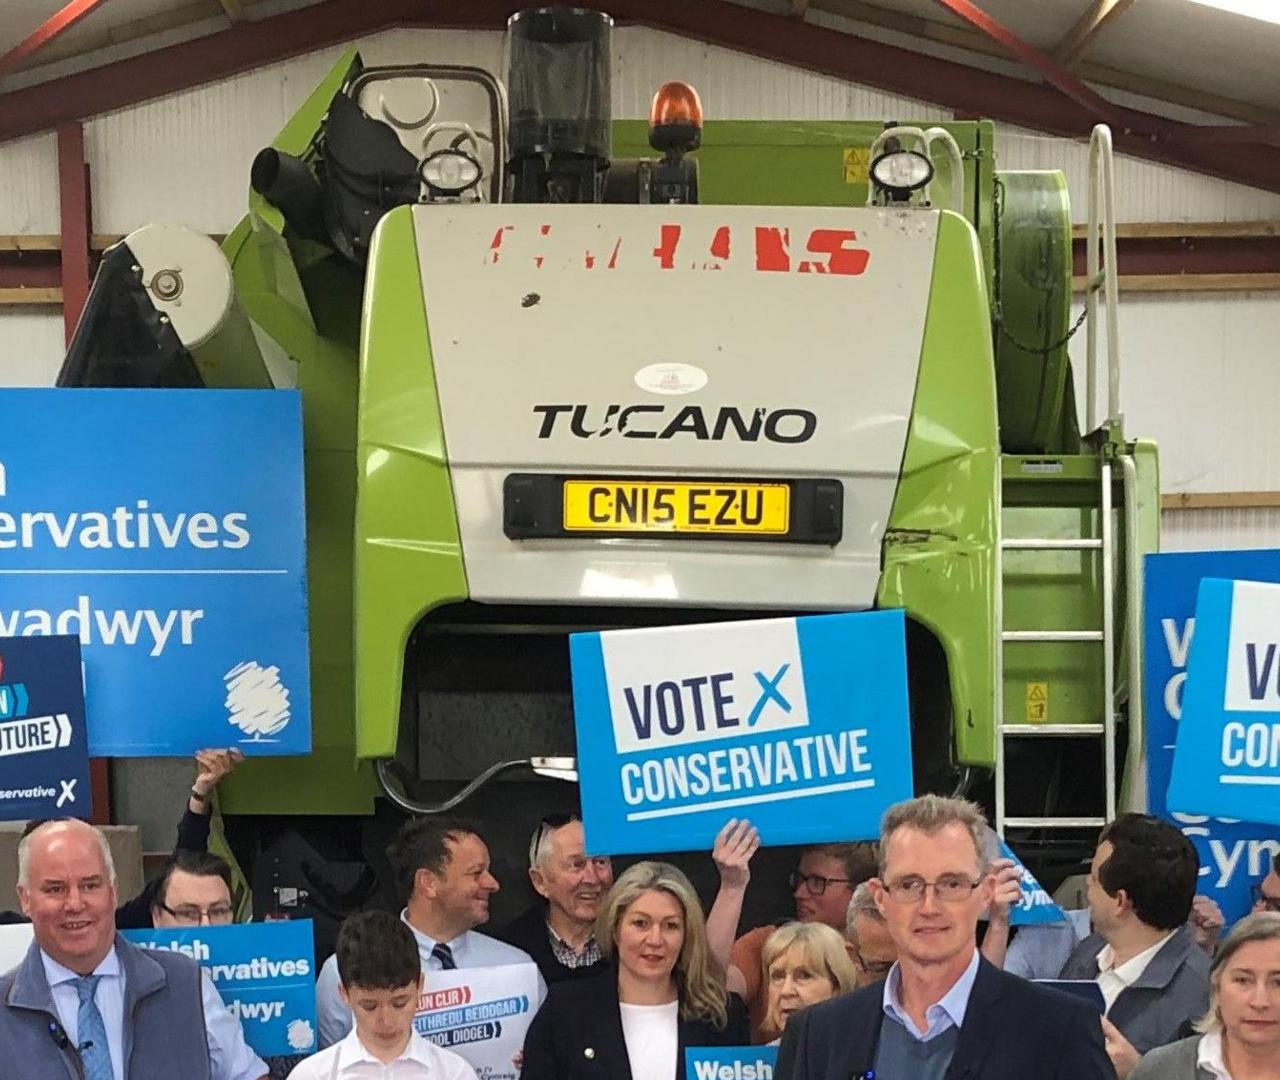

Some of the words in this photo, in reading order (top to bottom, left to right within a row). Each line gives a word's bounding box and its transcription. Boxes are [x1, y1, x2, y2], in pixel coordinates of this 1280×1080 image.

[533, 404, 817, 444] TUCANO
[588, 487, 675, 523] CN15
[688, 489, 763, 526] EZU
[624, 672, 739, 740] VOTE
[621, 728, 872, 806] CONSERVATIVE
[206, 957, 310, 981] rvatives
